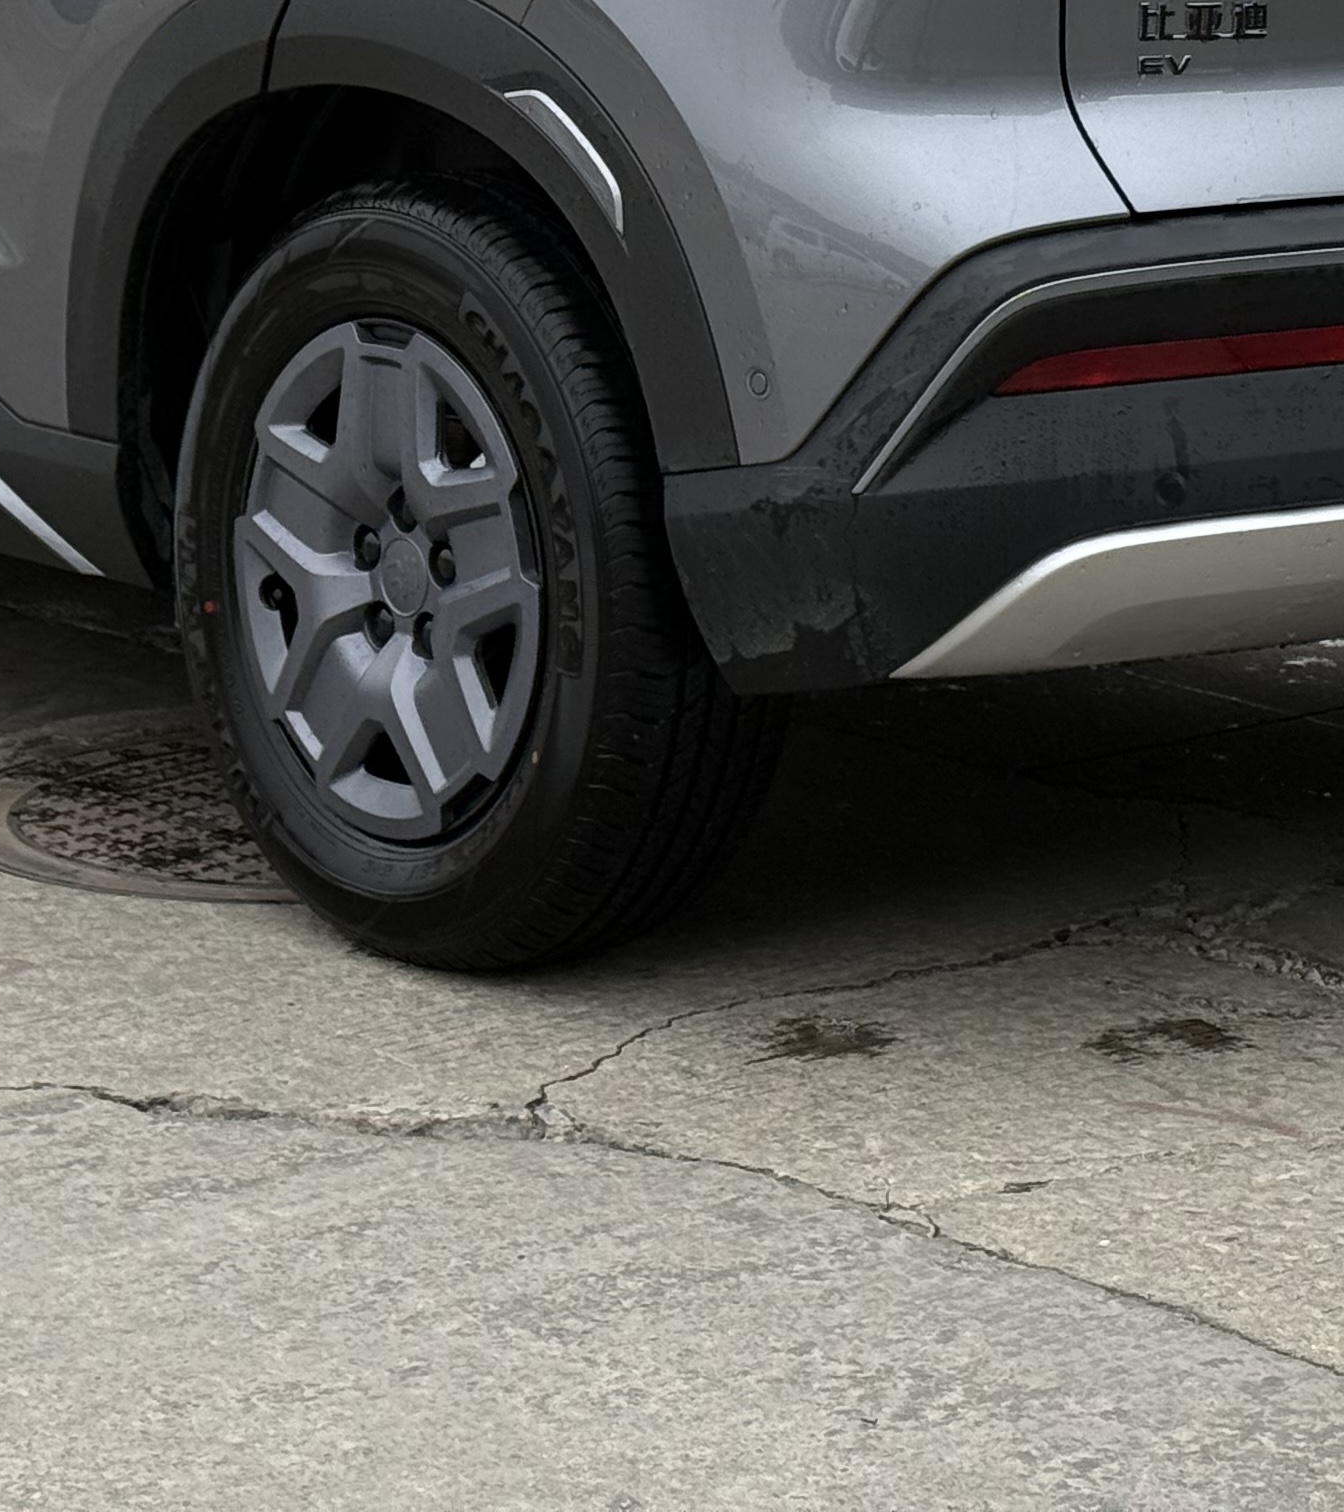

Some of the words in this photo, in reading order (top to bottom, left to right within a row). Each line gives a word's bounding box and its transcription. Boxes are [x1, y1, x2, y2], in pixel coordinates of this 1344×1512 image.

[1138, 0, 1268, 41] 比亚迪
[1137, 54, 1192, 76] EV
